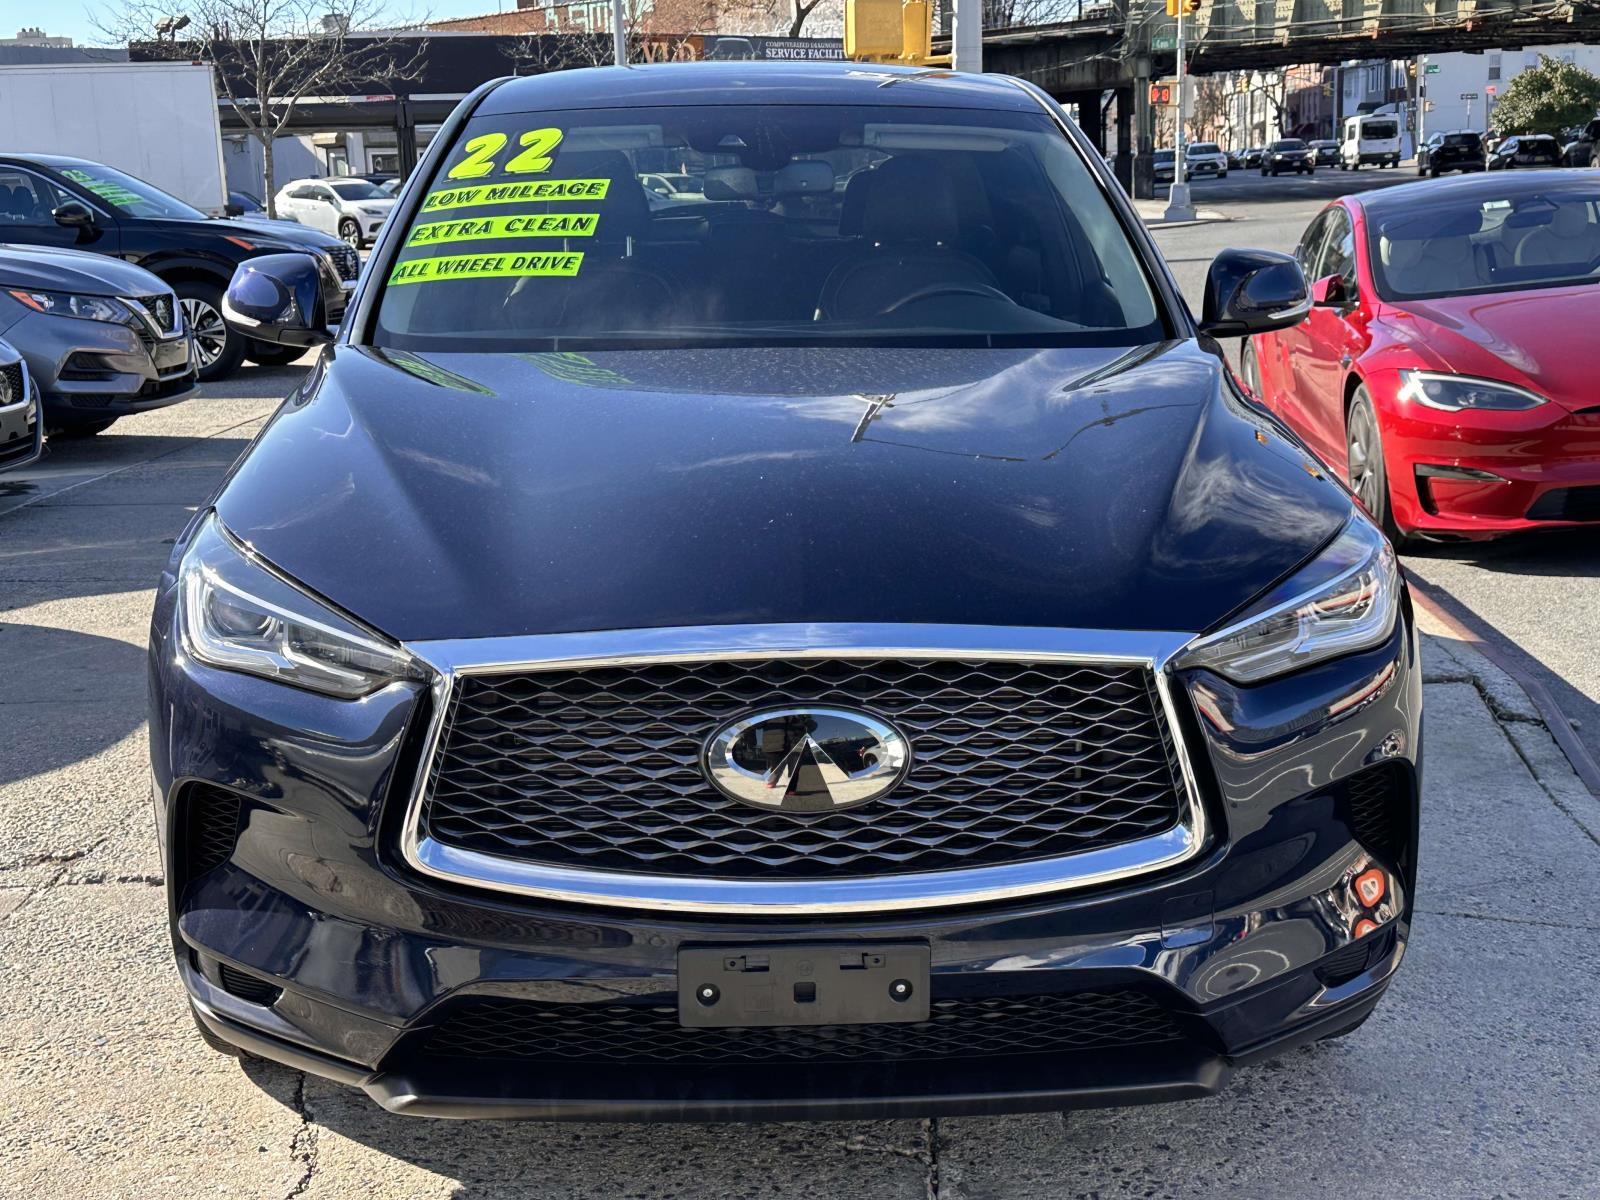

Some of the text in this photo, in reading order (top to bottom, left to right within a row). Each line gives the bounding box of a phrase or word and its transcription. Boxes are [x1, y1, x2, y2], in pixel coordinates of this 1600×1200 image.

[765, 48, 845, 59] SERVICE FACILIT
[448, 127, 564, 178] 22
[424, 182, 604, 208] LOW MILEAGE
[410, 216, 594, 242] EXTRA CLEAN
[392, 255, 580, 280] ALL WHEEL DRIVE
